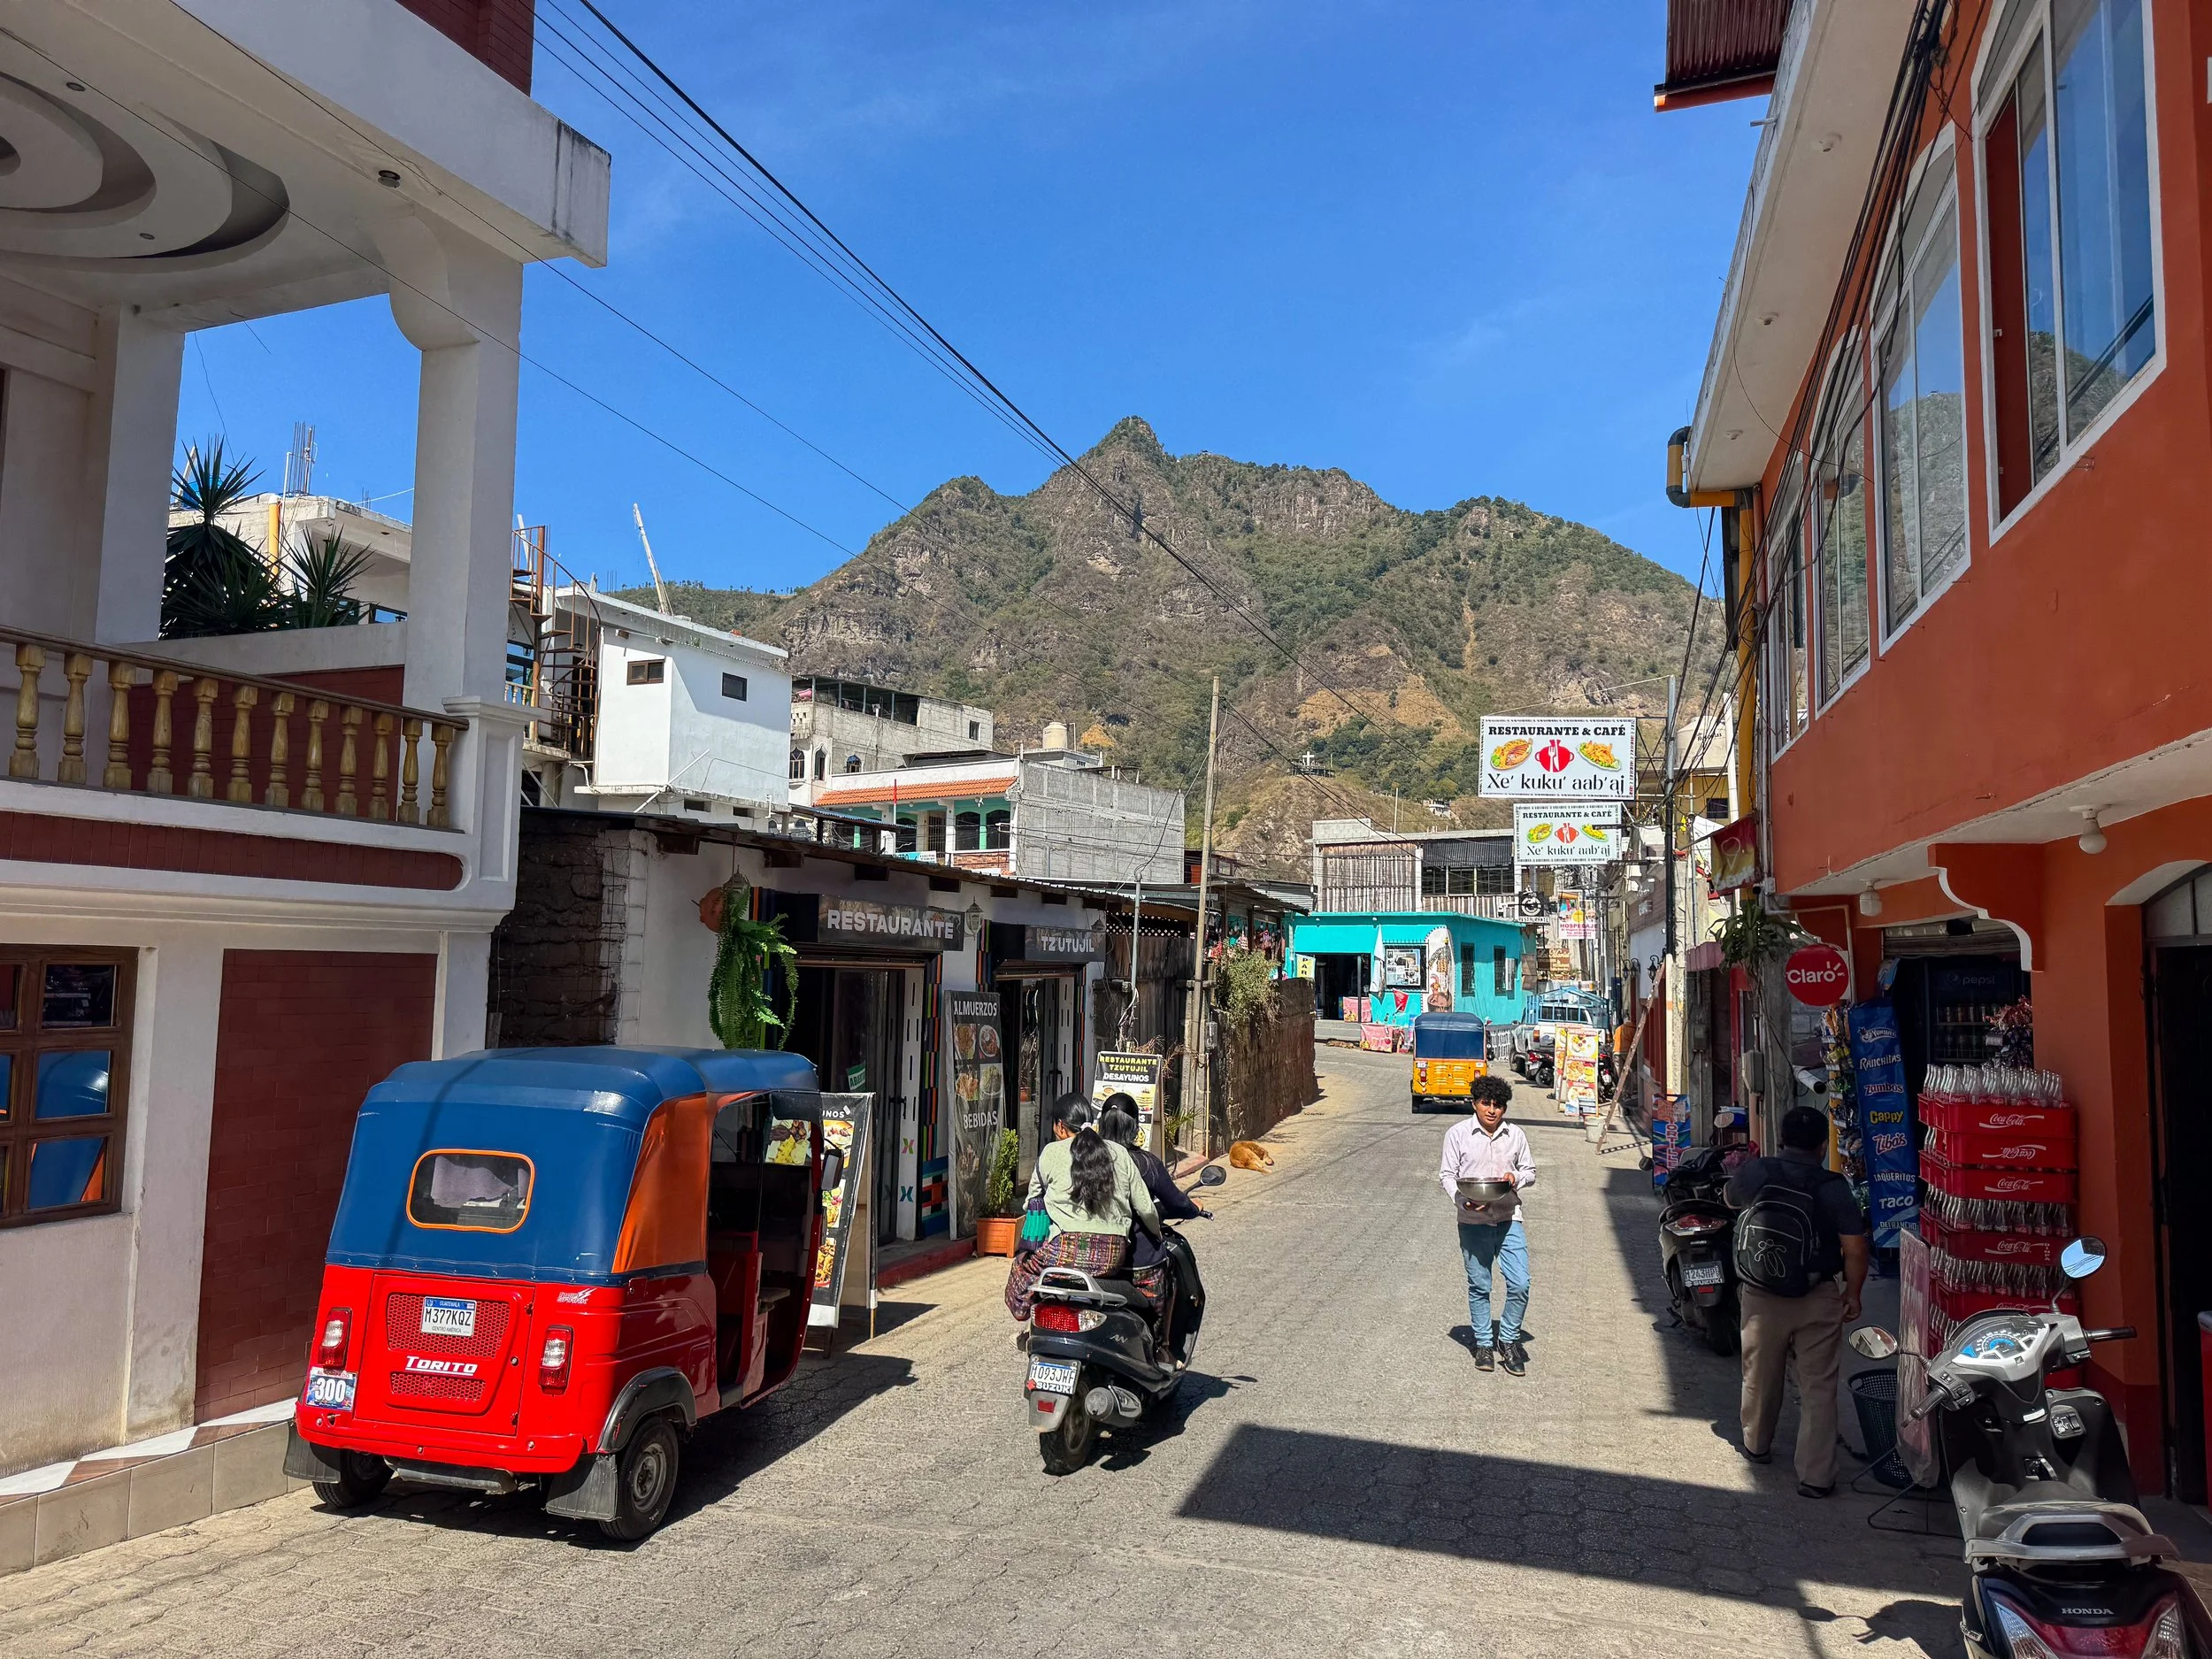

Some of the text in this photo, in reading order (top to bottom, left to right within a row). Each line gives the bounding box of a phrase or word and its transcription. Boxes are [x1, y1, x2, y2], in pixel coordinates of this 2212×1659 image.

[1488, 726, 1579, 736] RESTAURANTE
[1594, 725, 1626, 736] CAFÉ
[827, 909, 954, 939] RESTAURANTE
[1786, 968, 1837, 984] Claro
[954, 1000, 998, 1017] ALMUERZOS
[1099, 1056, 1157, 1065] RESTAURANTE
[1102, 1071, 1150, 1082] DESAYUNOS
[963, 1110, 998, 1130] BEBIDAS
[1870, 1110, 1904, 1125] Cappy
[1873, 1172, 1916, 1183] TAQUERITOS
[425, 1308, 472, 1326] M377KQZ
[314, 1377, 347, 1403] 300
[1035, 1380, 1074, 1394] SUZUKI
